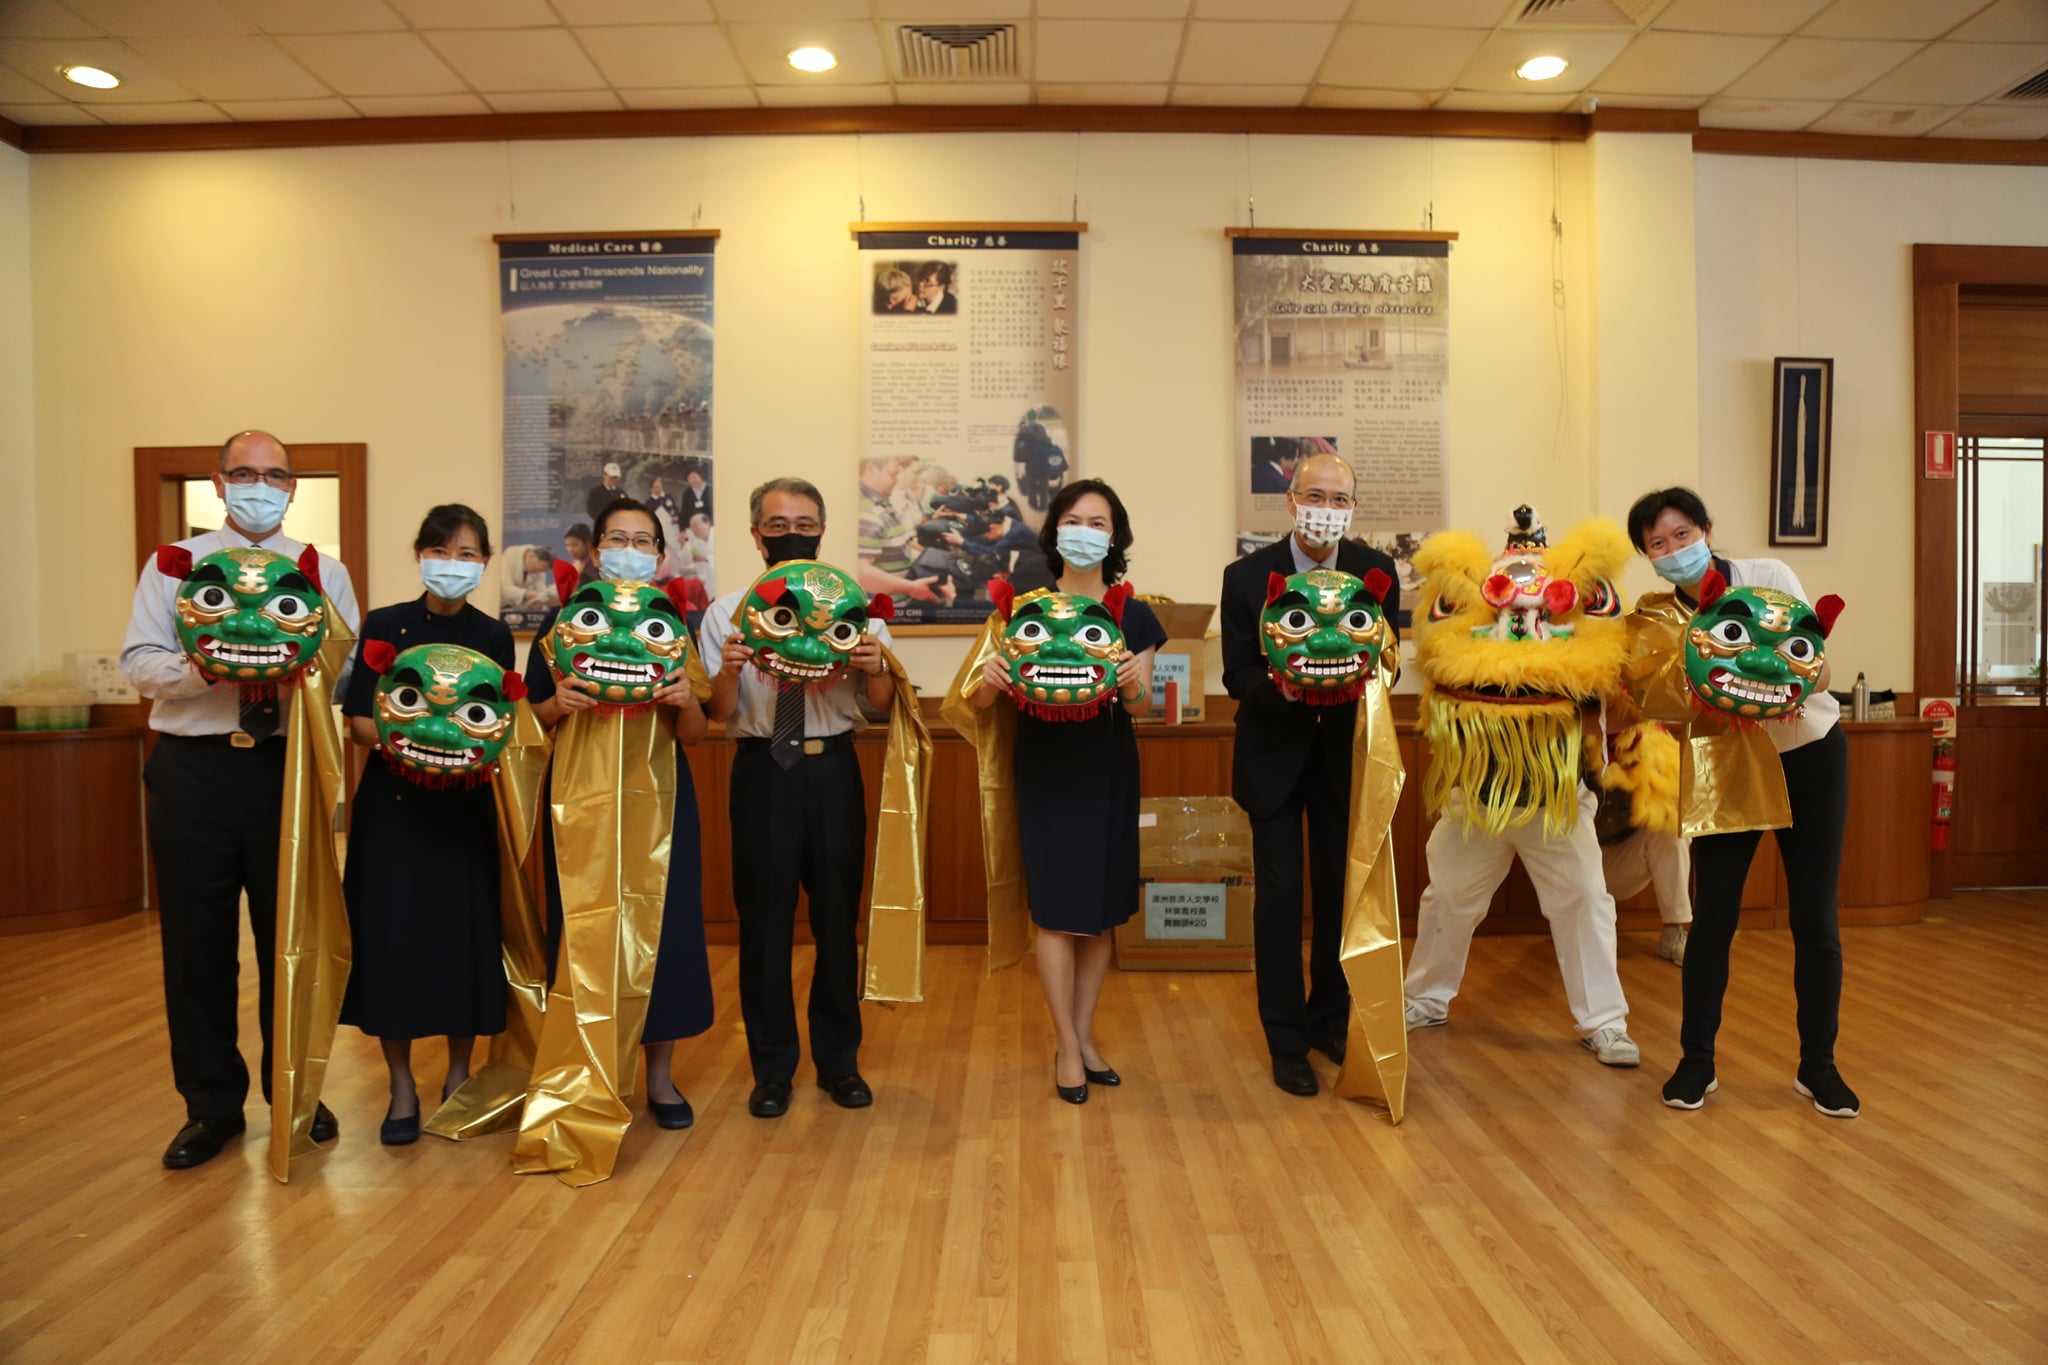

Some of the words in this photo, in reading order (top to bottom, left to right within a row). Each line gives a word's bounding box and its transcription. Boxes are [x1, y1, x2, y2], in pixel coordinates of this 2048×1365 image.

[548, 242, 600, 254] Medical
[603, 241, 635, 253] Care
[927, 234, 978, 248] Charity
[1302, 241, 1351, 254] Charity
[519, 268, 551, 279] Great
[552, 267, 580, 278] Love
[582, 265, 645, 277] Transcends
[647, 264, 705, 276] Nationality
[1275, 303, 1300, 315] Love
[1304, 304, 1327, 315] can
[1331, 303, 1371, 316] bridge
[1375, 304, 1434, 315] obstacles
